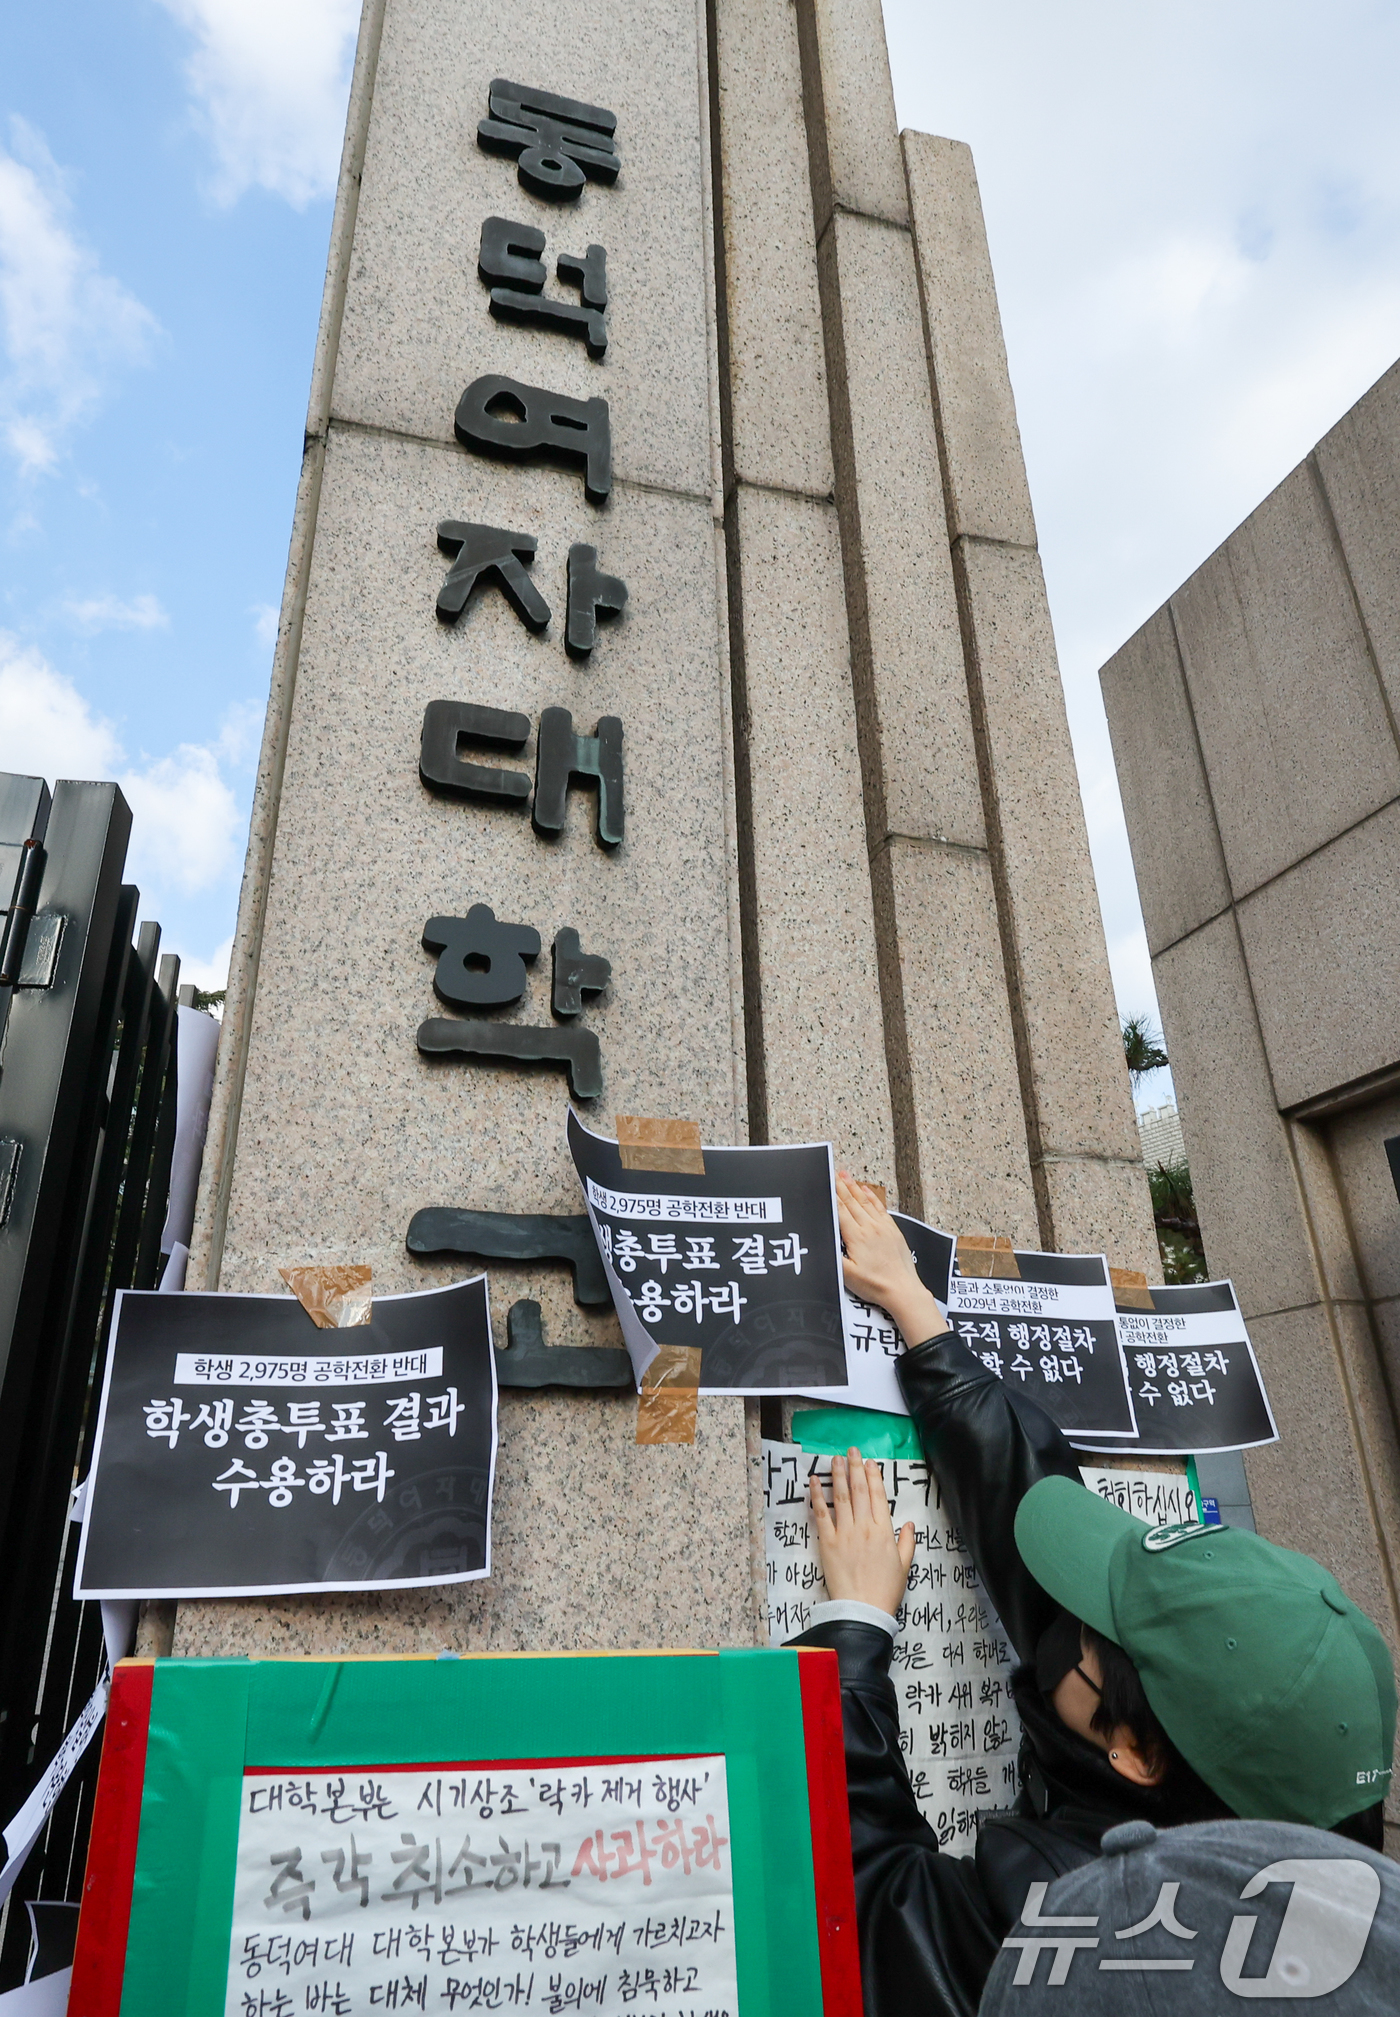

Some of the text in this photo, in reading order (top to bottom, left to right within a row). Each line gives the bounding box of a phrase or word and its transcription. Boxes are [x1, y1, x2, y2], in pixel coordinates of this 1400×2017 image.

[592, 1185, 767, 1219] 학생 2,975명 공학전환 반대
[732, 1233, 808, 1275] 결과
[618, 1279, 747, 1324] 용하라
[957, 1297, 1043, 1315] 2029년 공학전환
[1027, 1286, 1059, 1301] 결정한
[947, 1318, 1001, 1350] 주적
[1007, 1322, 1097, 1354] 행정절차
[1125, 1331, 1169, 1345] 공학전환
[1152, 1317, 1186, 1331] 결정한
[194, 1353, 427, 1383] 학생 2,975명 공학전환 반대
[1010, 1354, 1034, 1382] 수
[1039, 1354, 1084, 1385] 없다
[1134, 1350, 1229, 1378] 행정절차
[1138, 1379, 1216, 1407] 수 없다
[143, 1387, 466, 1450] 학생총투표 결과
[211, 1451, 395, 1509] 수용하라
[955, 1602, 989, 1633] 우리는
[943, 1641, 964, 1667] 다시
[905, 1681, 942, 1714] 락카
[929, 1719, 976, 1757] 밝히지
[983, 1715, 1013, 1752] 않고
[417, 1777, 529, 1819] 시기상조
[601, 1776, 642, 1808] 제거
[263, 1814, 729, 1921] 즉각 취소하고 사과하라
[240, 1909, 726, 1979] 동덕여대 대학본부가 학생들에게 가르치고자
[241, 1987, 295, 2017] 하는
[306, 1980, 352, 2016] 바는
[370, 1974, 428, 2012] 대체
[541, 1973, 608, 2015] 불의에
[618, 1966, 703, 2003] 침묵하고
